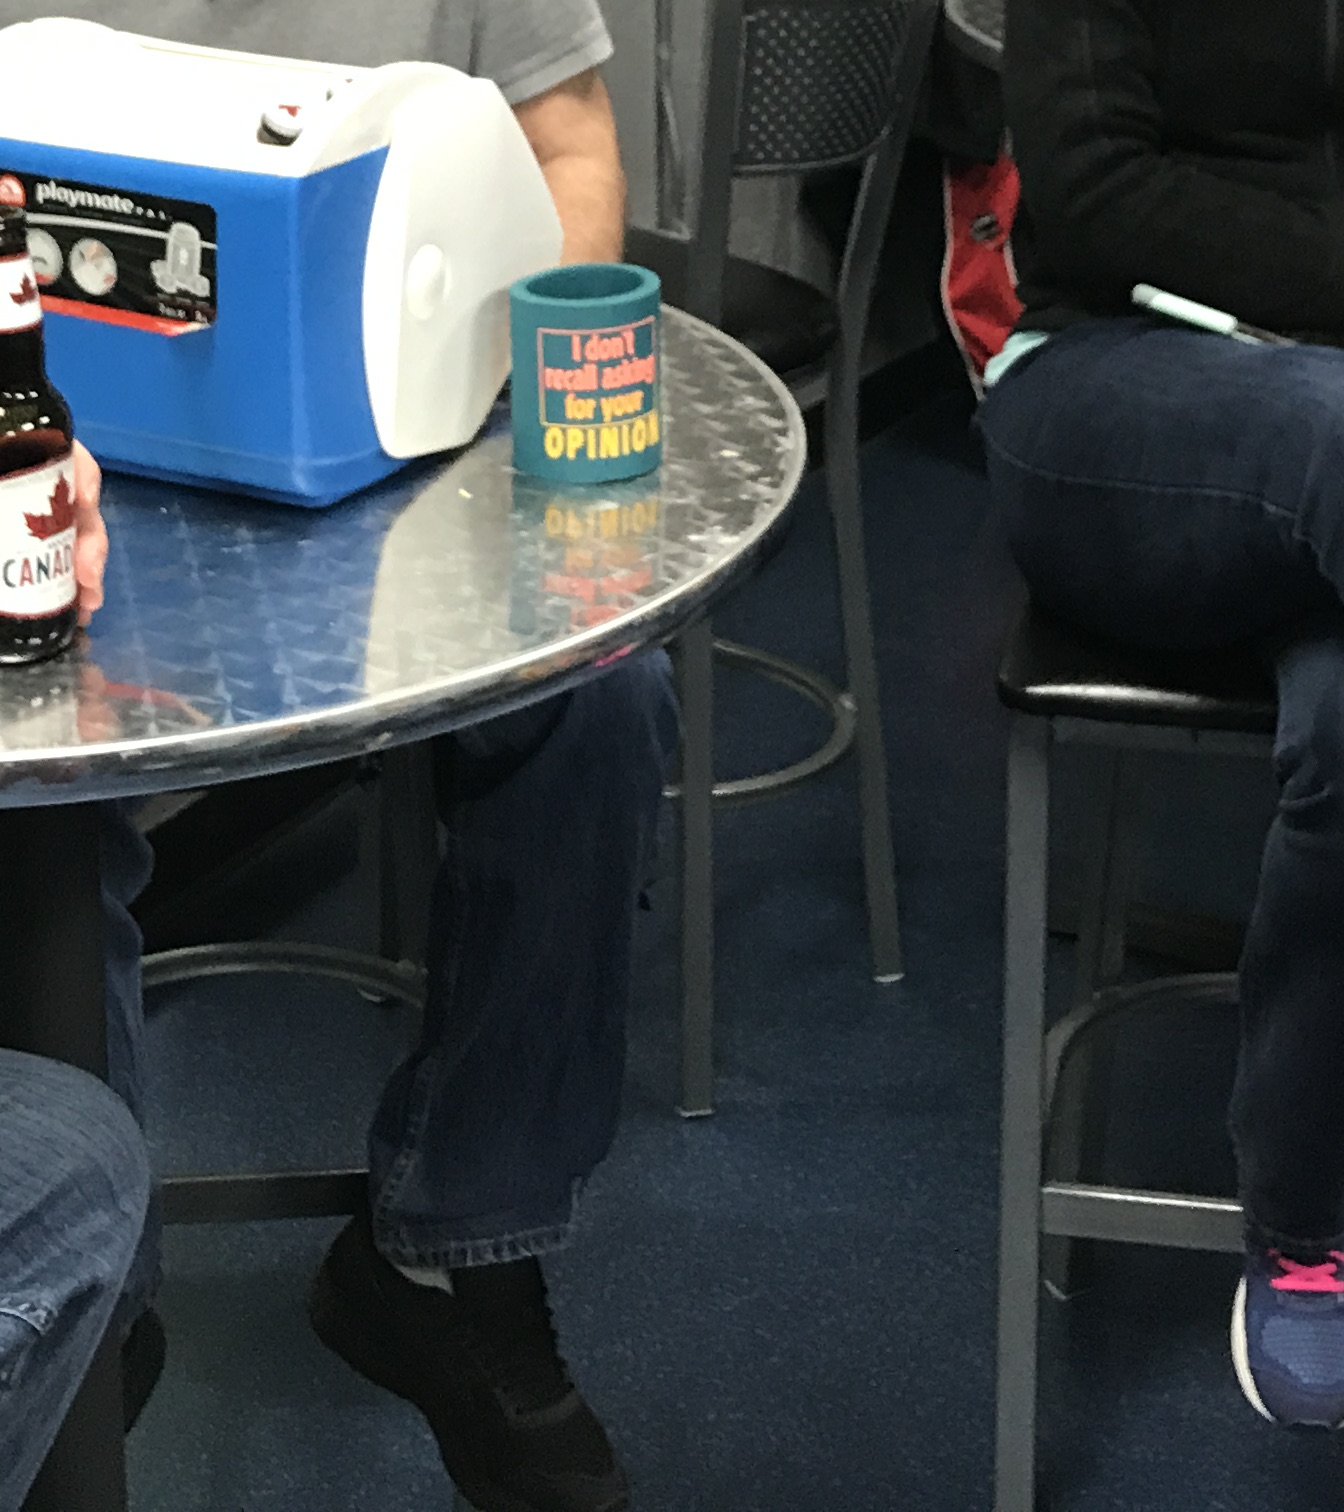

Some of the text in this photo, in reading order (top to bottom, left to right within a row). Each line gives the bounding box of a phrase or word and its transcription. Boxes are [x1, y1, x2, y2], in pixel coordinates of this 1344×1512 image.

[36, 180, 135, 214] playmate
[565, 390, 644, 423] for your
